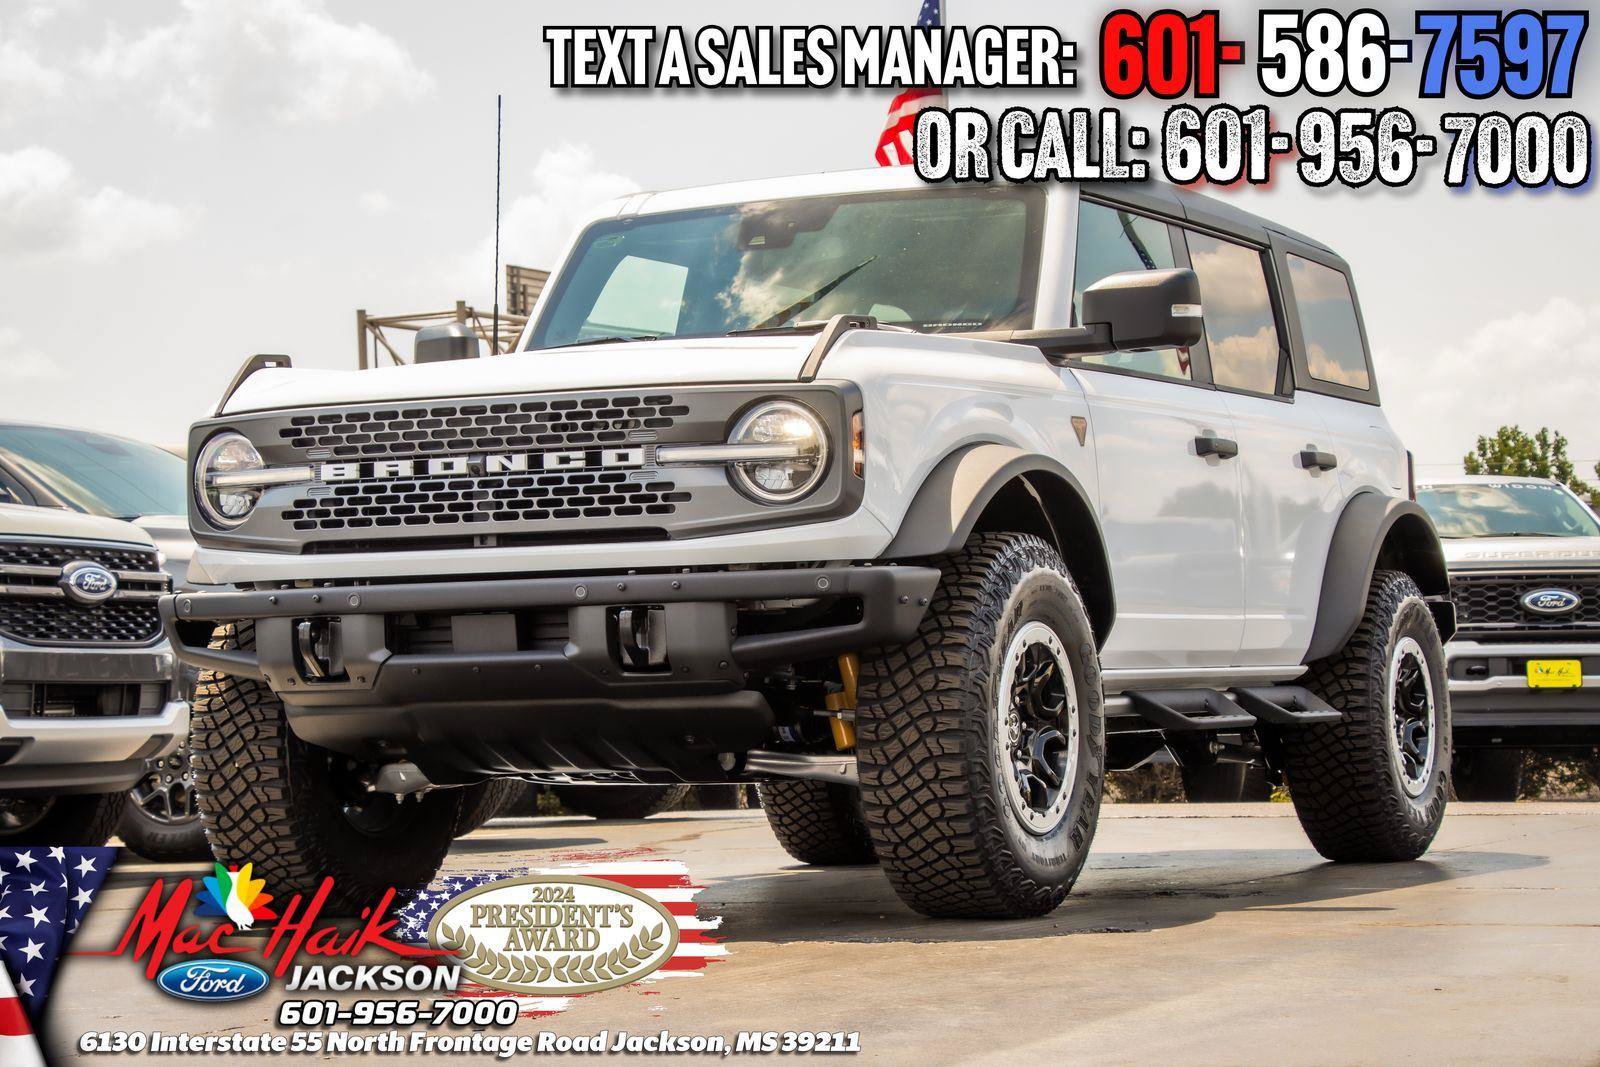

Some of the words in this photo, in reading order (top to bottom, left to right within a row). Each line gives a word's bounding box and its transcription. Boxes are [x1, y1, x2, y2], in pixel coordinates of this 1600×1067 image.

[320, 446, 646, 482] BRONCO
[82, 573, 108, 591] Ford
[1537, 597, 1567, 607] Ford
